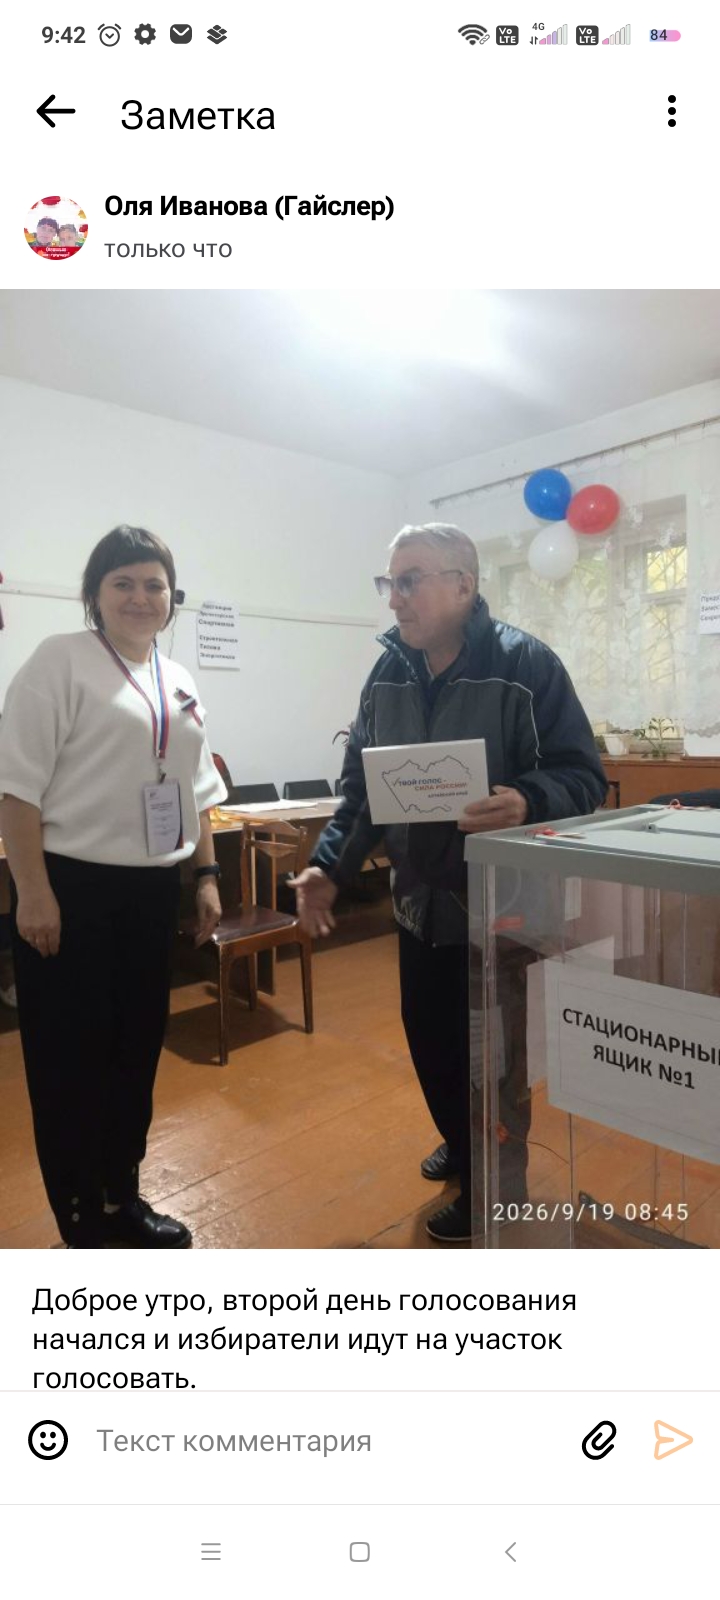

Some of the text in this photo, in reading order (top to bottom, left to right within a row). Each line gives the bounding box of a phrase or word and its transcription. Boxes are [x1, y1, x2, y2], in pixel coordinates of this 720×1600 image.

[41, 26, 86, 44] 9:42
[531, 22, 545, 31] 4G
[649, 28, 668, 42] 84
[120, 99, 276, 131] Заметка
[104, 194, 395, 221] Оля Иванова (Гайслер)
[104, 241, 233, 258] только что
[399, 778, 417, 787] ТВОЙ
[562, 1008, 720, 1066] СТАЦИОНАРНЫ
[593, 1045, 695, 1089] ЯЩИК №1
[31, 1287, 576, 1317] Доброе утро, второй день голосования
[33, 1326, 563, 1356] начался и избиратели идут на участок
[33, 1371, 196, 1389] голосовать.
[96, 1429, 372, 1458] Текст комментария
